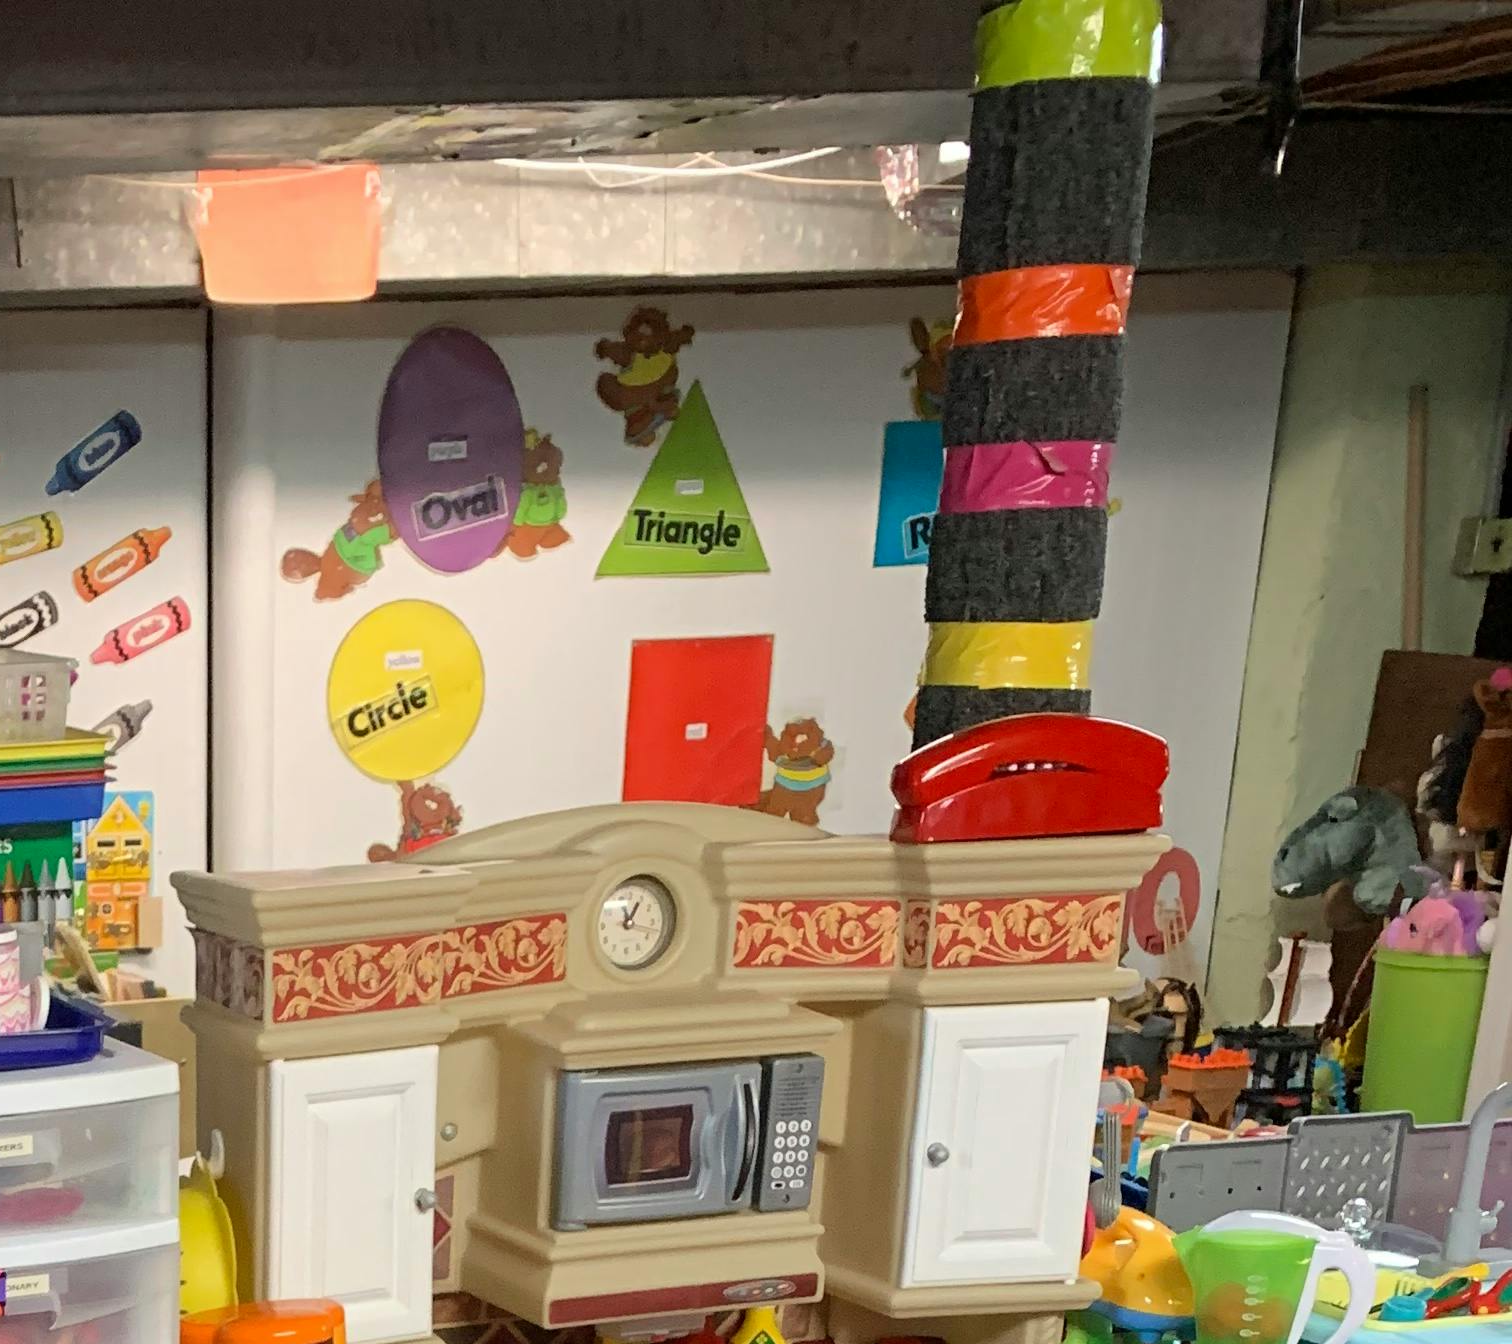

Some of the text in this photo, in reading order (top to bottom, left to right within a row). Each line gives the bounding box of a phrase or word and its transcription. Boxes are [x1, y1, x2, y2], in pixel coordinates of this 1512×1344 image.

[422, 475, 501, 530] Oval
[633, 509, 742, 555] Triangle
[346, 681, 428, 739] Circle
